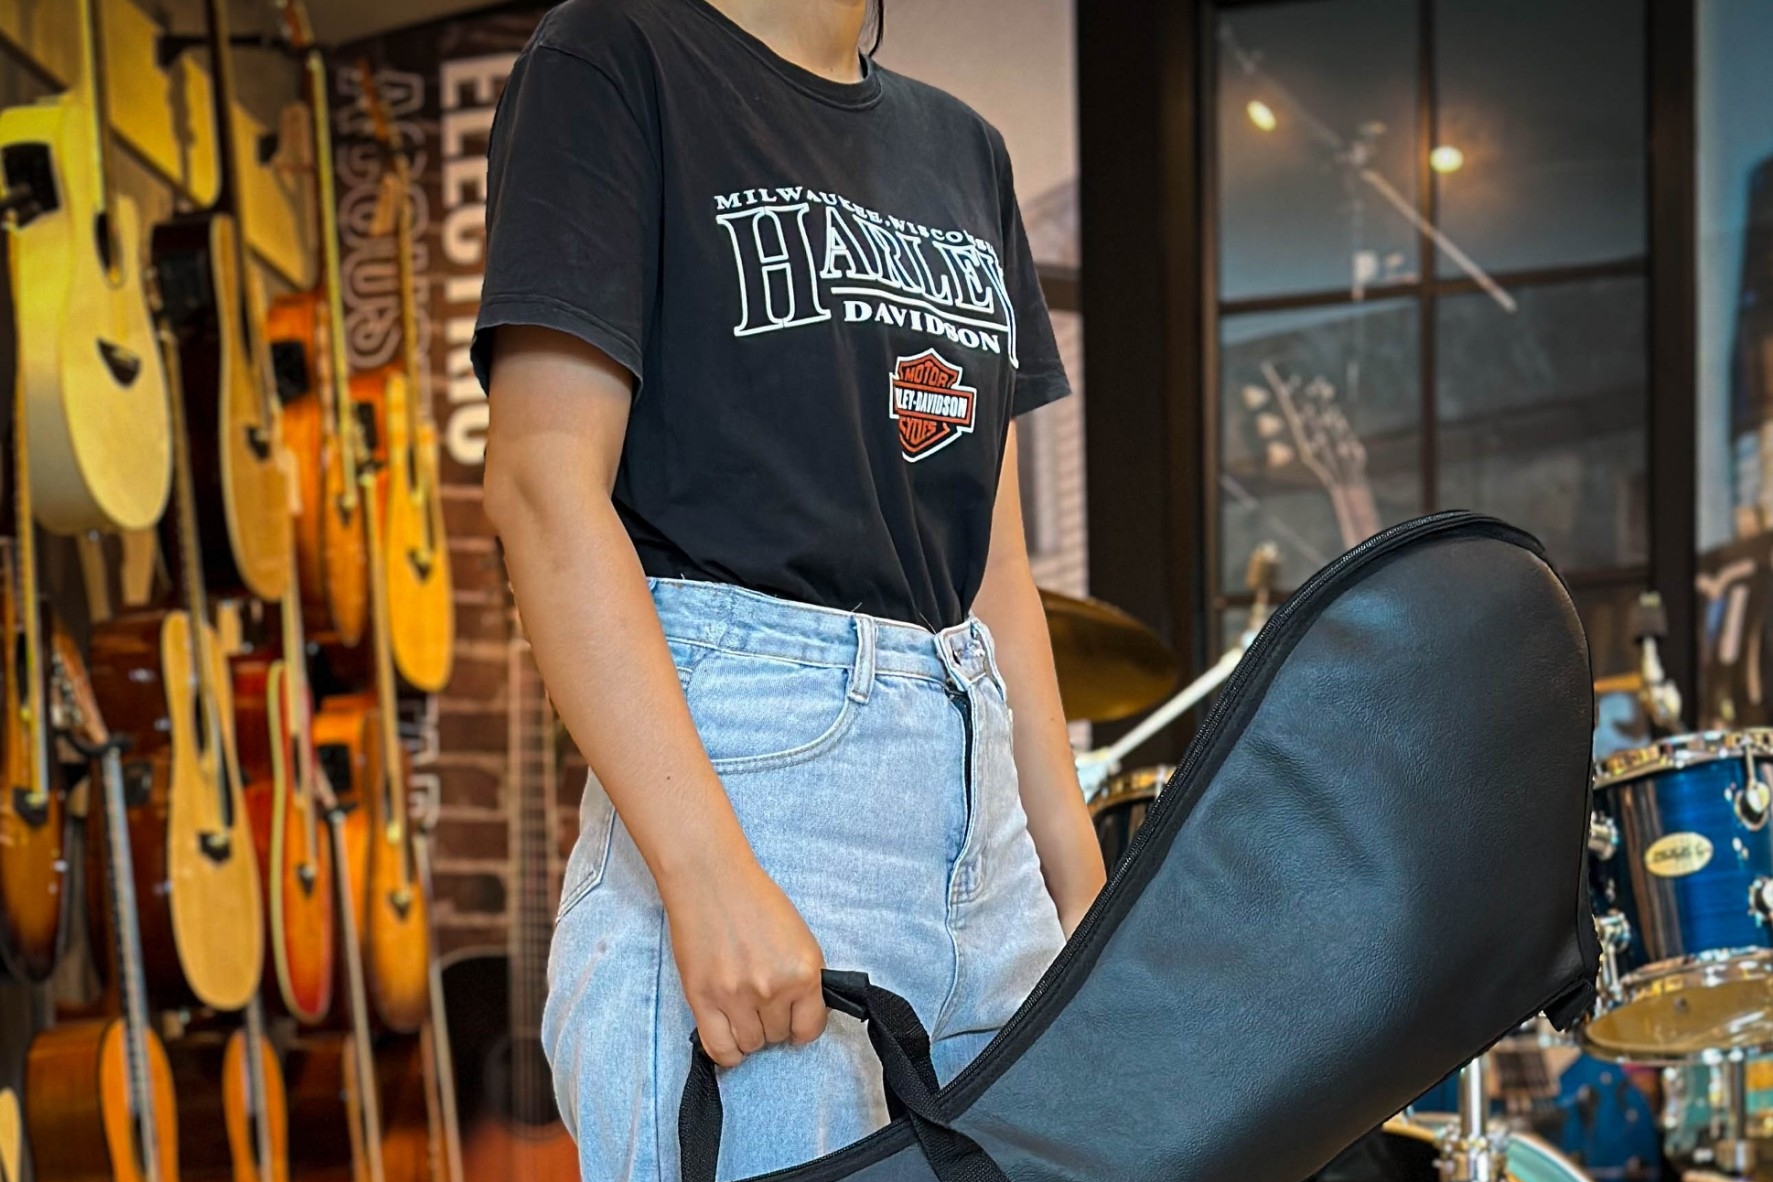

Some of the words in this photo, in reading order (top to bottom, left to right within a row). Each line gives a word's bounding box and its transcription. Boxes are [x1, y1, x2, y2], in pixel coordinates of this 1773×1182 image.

[716, 203, 1019, 369] HARLEY
[843, 300, 1001, 354] DAVIDSON
[904, 361, 949, 388] MOTOR
[894, 387, 968, 419] LEY-DAVIDSON
